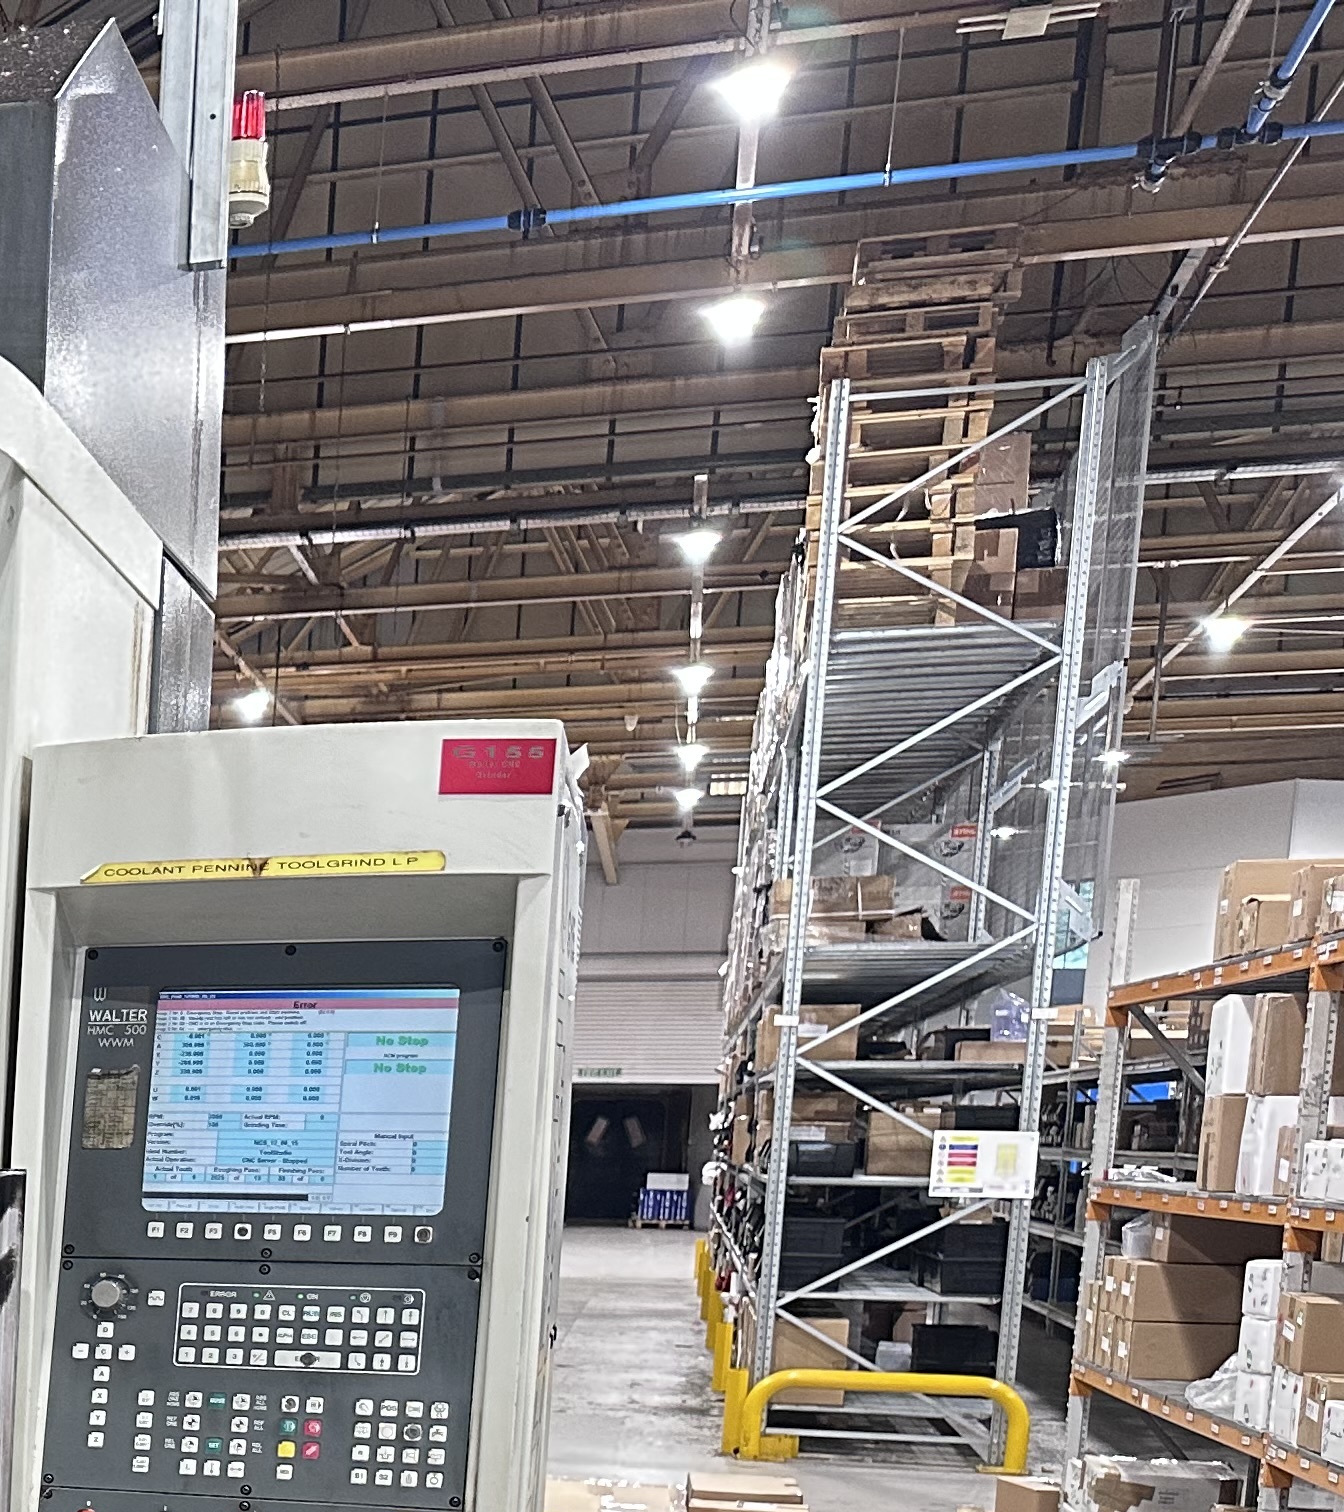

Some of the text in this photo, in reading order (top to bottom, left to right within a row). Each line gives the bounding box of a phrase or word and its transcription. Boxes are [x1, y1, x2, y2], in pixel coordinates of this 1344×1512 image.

[104, 864, 187, 877] COOLANT
[192, 861, 269, 875] PENNINE
[276, 857, 386, 870] TOOLGRIND
[293, 1001, 317, 1009] Error
[89, 1009, 148, 1021] WALTER
[87, 1025, 114, 1035] HMC
[124, 1025, 147, 1035] 500
[98, 1038, 134, 1047] WWM
[376, 1036, 428, 1047] No Stop
[373, 1063, 427, 1074] No Stop
